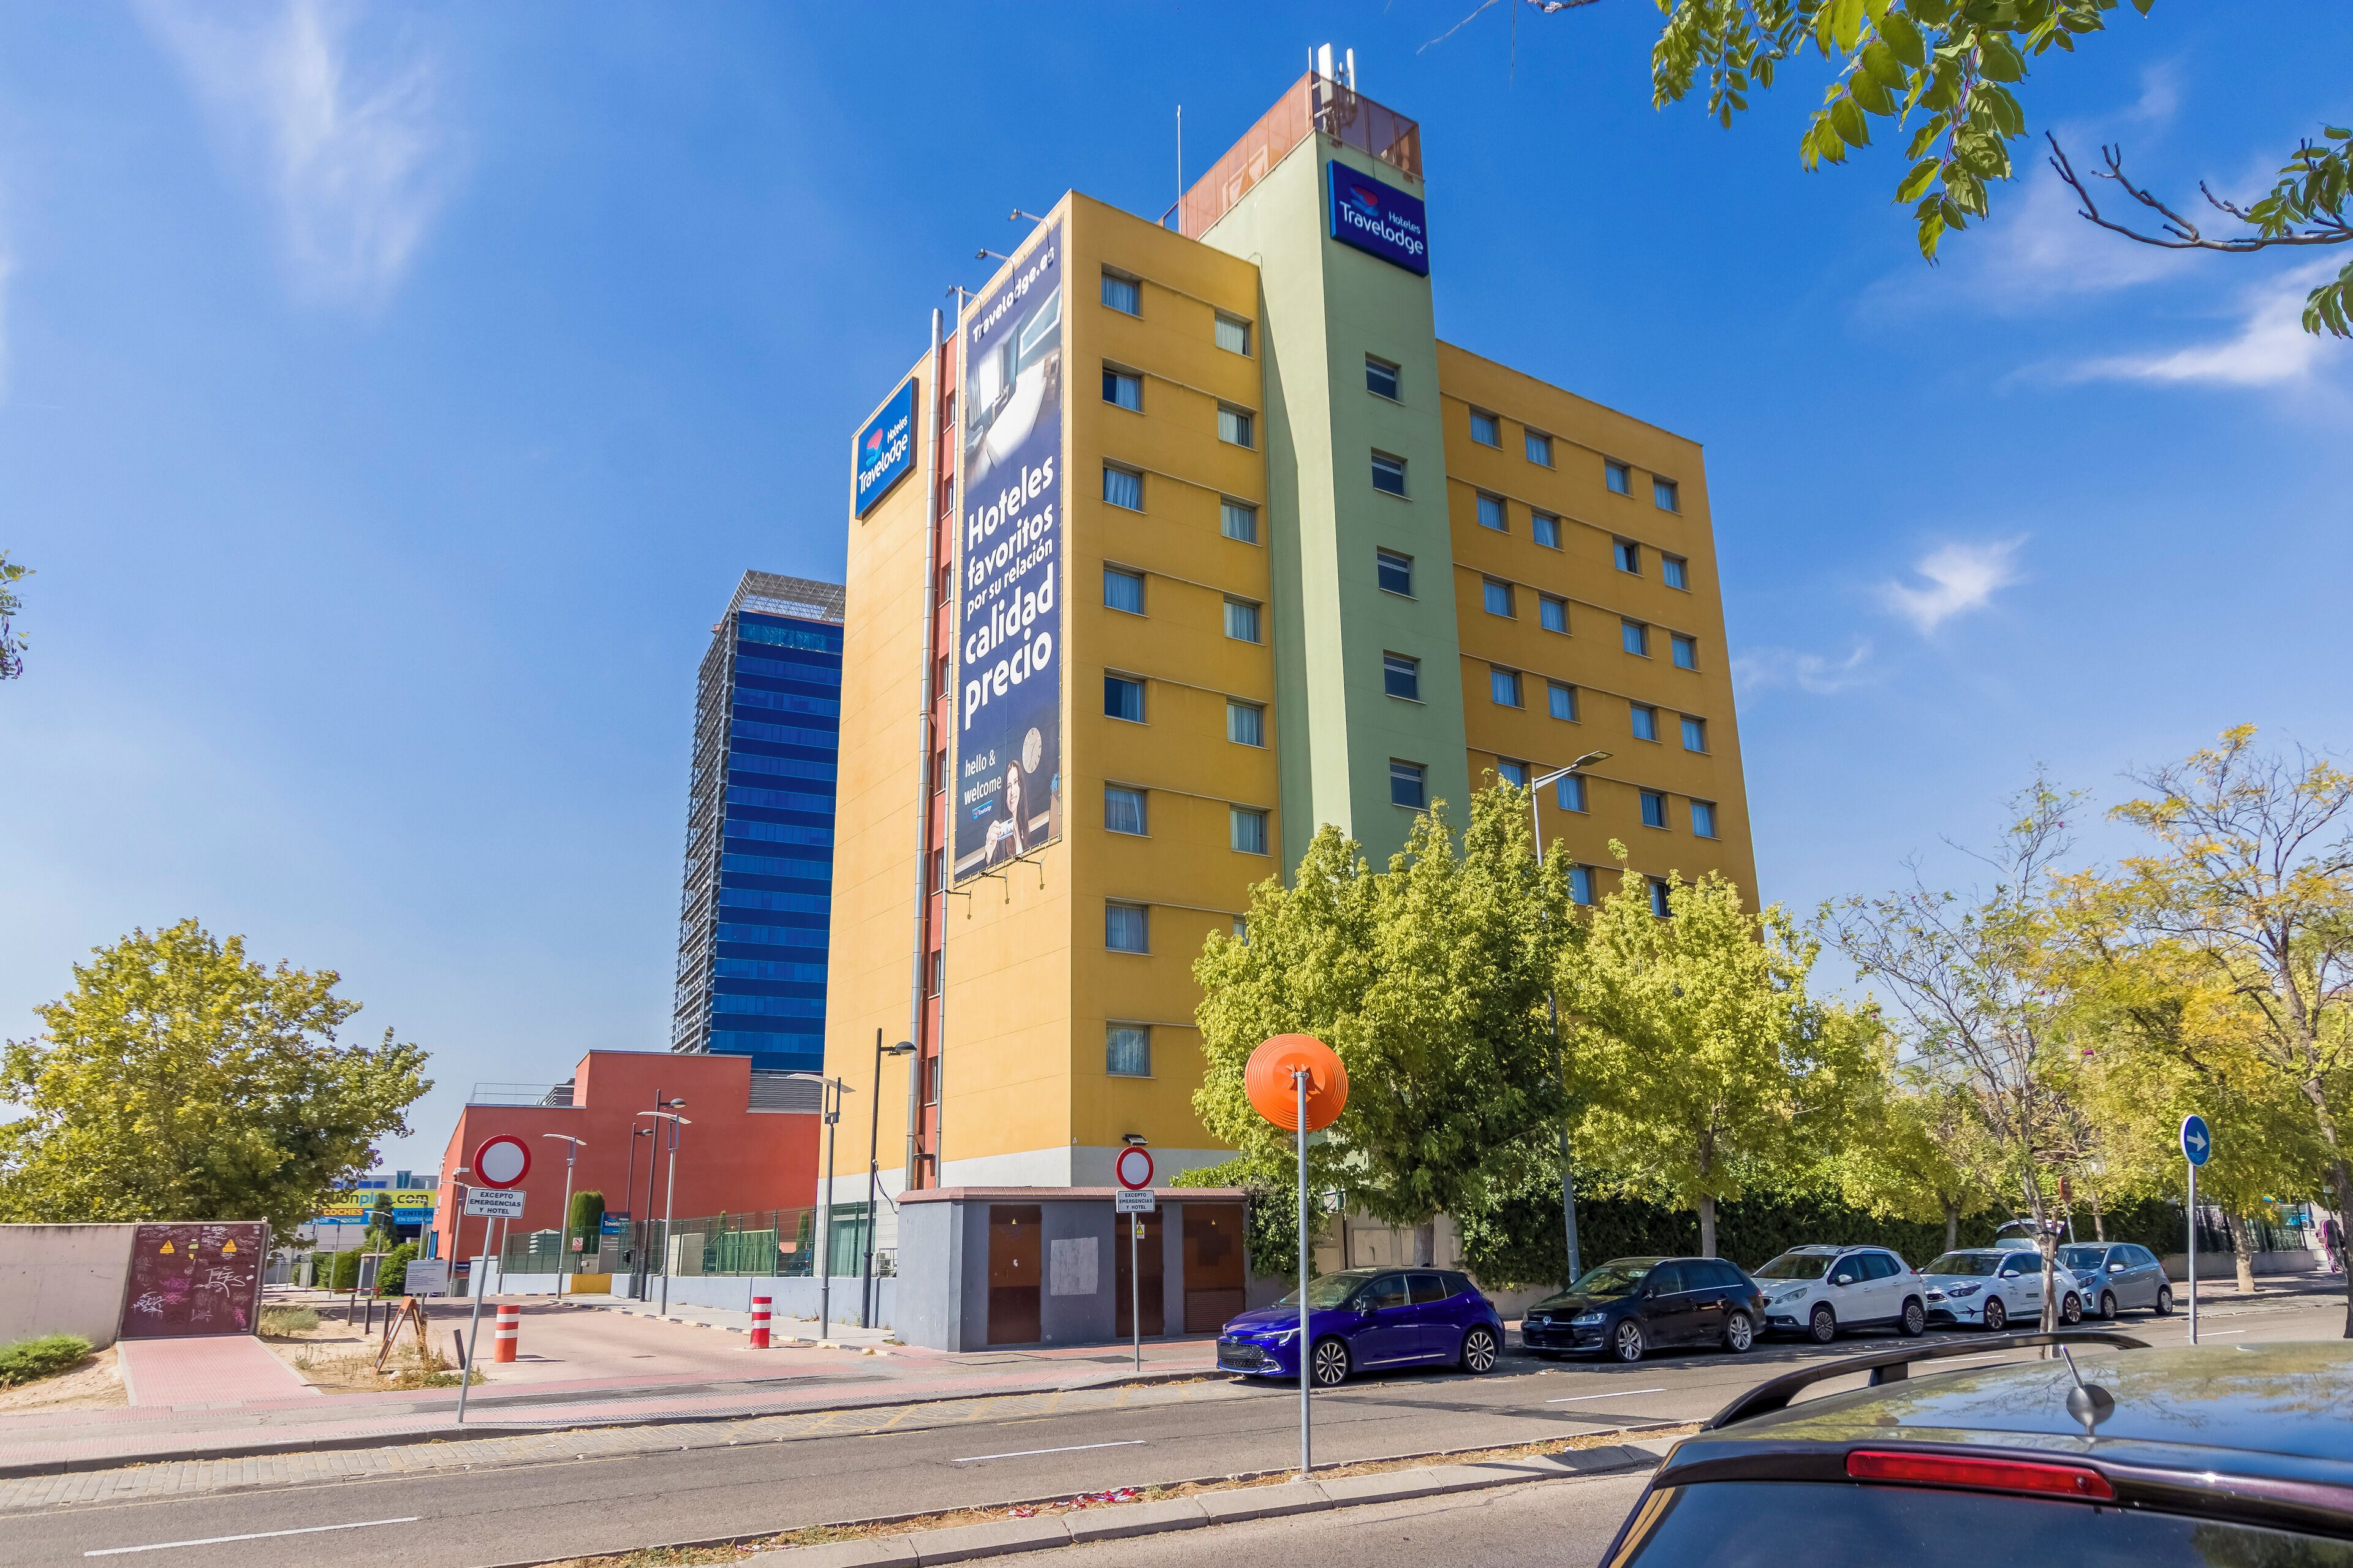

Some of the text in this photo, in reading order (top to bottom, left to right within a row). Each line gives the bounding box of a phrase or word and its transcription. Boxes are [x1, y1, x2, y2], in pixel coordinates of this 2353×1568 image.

[1339, 200, 1423, 254] Travelodge
[1389, 211, 1421, 235] Hoteles
[972, 246, 1055, 343] Travelodge.es
[859, 434, 908, 494] Travelodge
[887, 415, 908, 444] Hoteles
[968, 456, 1053, 551] Hoteles
[967, 538, 1053, 621] por su relación
[968, 504, 1053, 591] favoritos
[965, 561, 1053, 664] calidad
[965, 627, 1052, 730] precio
[964, 776, 1002, 805] welcome
[965, 749, 996, 778] hello &
